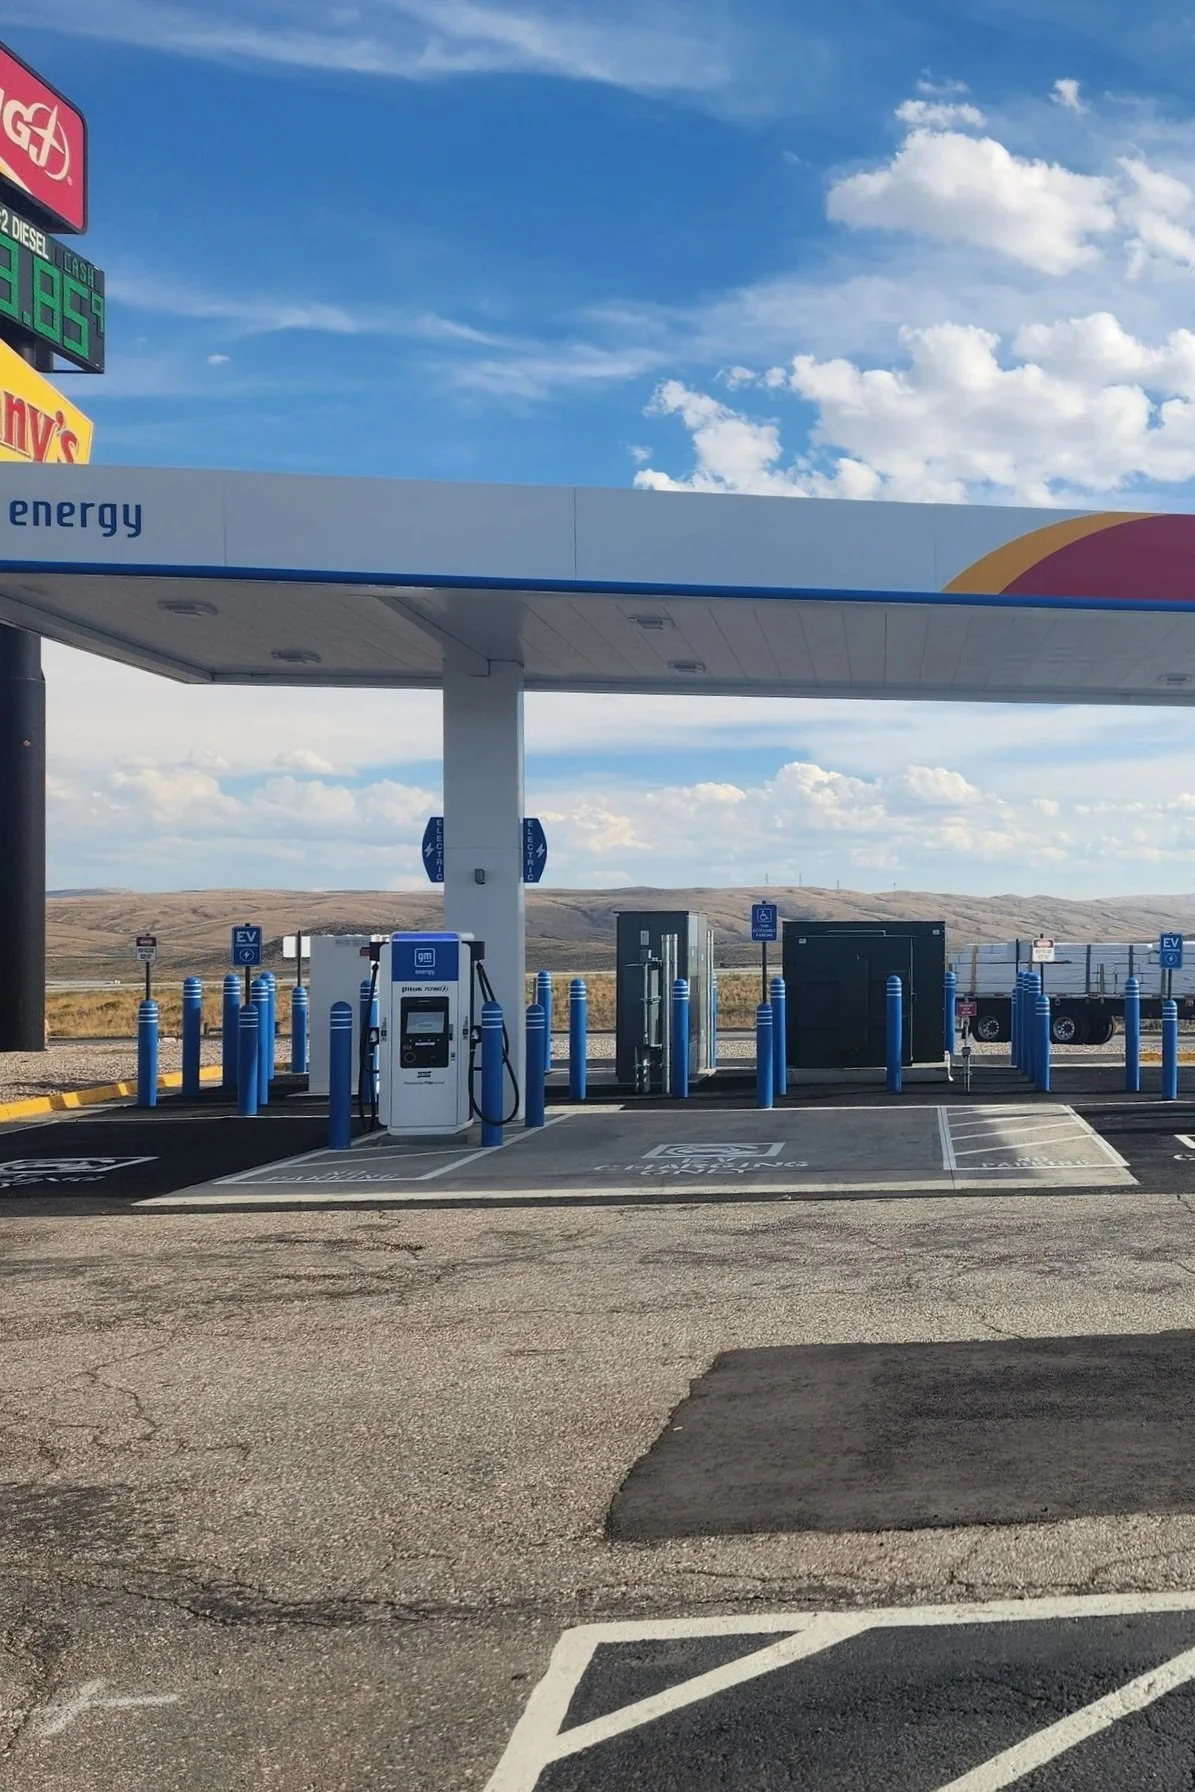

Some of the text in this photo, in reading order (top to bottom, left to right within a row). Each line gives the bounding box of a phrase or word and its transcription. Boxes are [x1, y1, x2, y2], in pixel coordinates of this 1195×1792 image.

[12, 215, 49, 260] DIESEL
[63, 252, 95, 289] CASH
[9, 500, 142, 538] energy
[236, 931, 257, 943] EV
[1163, 937, 1179, 948] EV
[418, 952, 432, 963] gm
[593, 1161, 809, 1170] CHARGING
